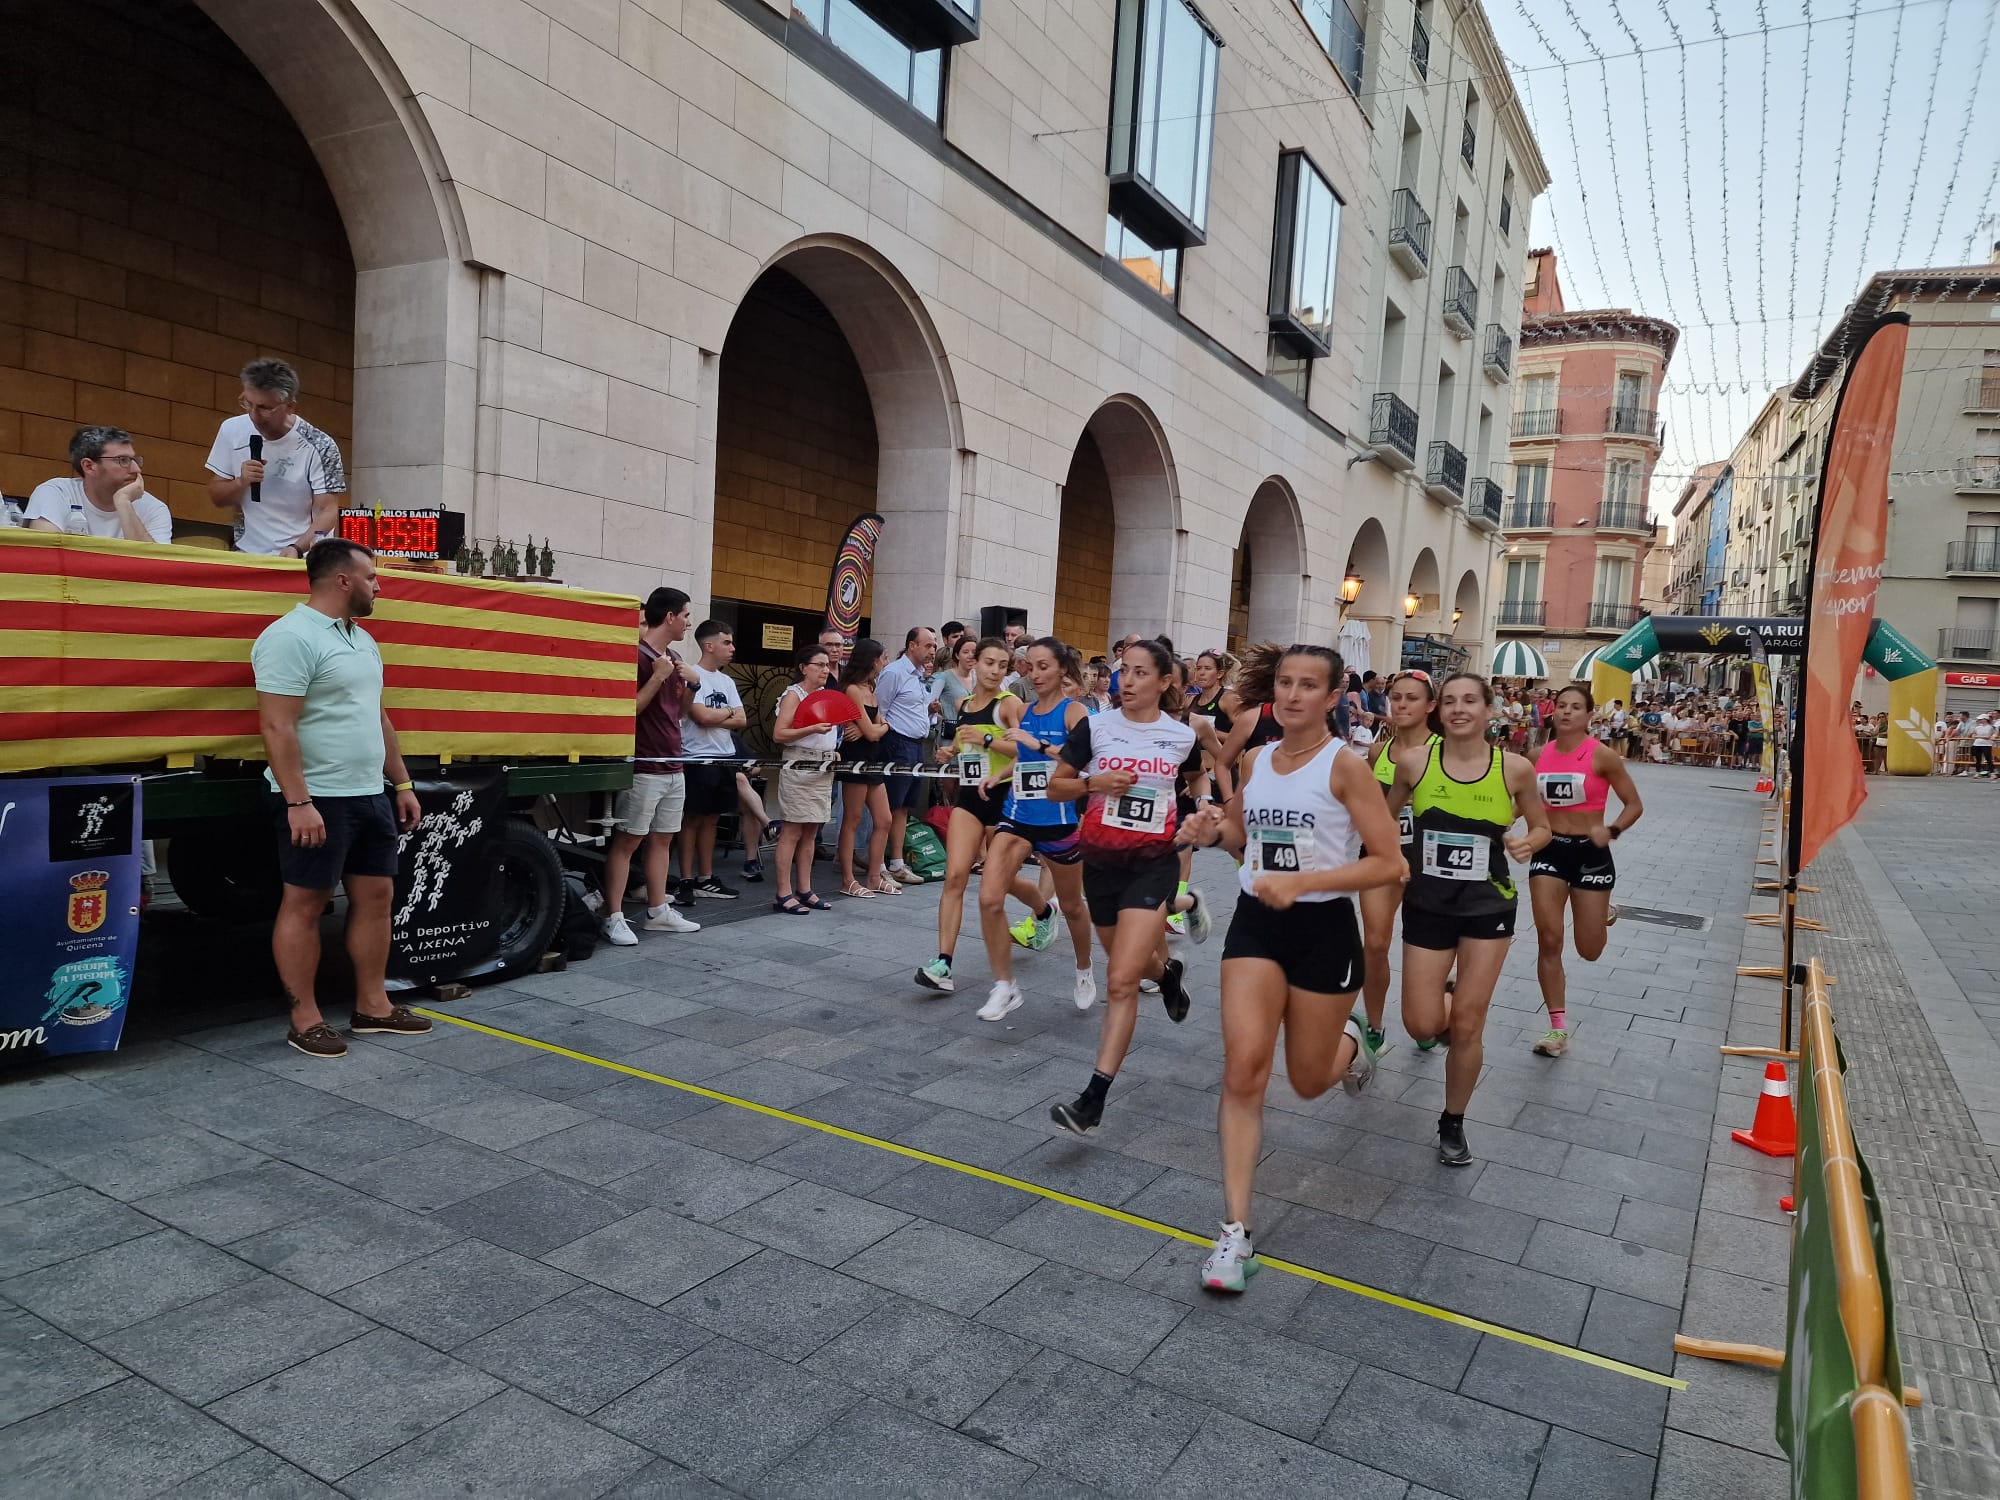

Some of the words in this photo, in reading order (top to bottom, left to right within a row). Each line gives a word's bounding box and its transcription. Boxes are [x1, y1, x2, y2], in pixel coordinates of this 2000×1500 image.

[341, 509, 373, 517] JOYERIA
[409, 510, 440, 519] BAILIN
[1960, 675, 1988, 684] GAES
[968, 764, 980, 776] 41
[1028, 774, 1047, 788] 46
[1555, 784, 1571, 797] 44
[1129, 801, 1151, 819] 51
[1243, 809, 1316, 829] ARBES
[1273, 847, 1297, 868] 49
[1448, 849, 1472, 866] 42
[1581, 874, 1613, 884] PRO
[417, 921, 490, 937] Deportivo
[56, 937, 106, 947] Ayuntamiento
[66, 943, 104, 952] Quicena
[409, 951, 457, 964] QUIZENA
